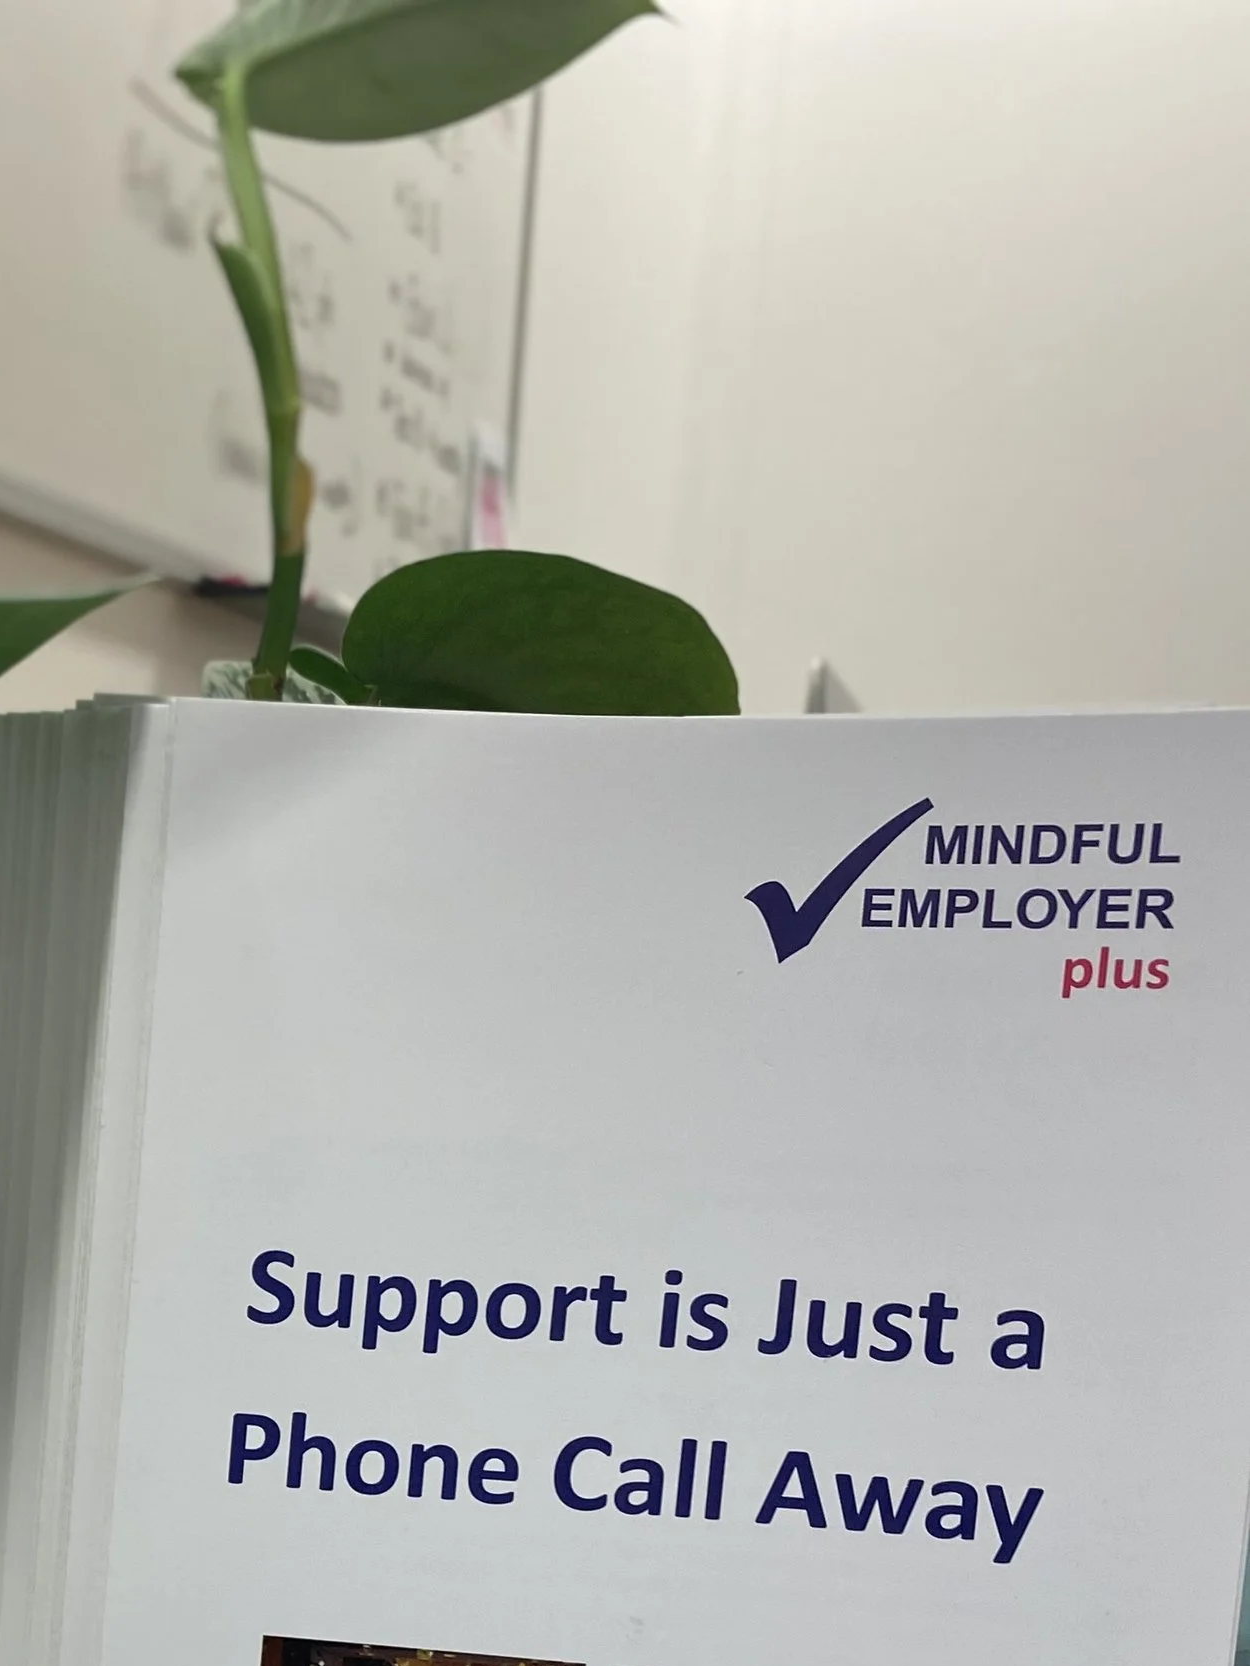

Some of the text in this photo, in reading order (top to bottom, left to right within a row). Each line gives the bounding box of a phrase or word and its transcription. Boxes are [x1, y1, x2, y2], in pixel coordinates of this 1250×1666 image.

[924, 823, 1181, 865] MINDFUL
[861, 889, 1174, 929] EMPLOYER
[1061, 946, 1170, 998] plus
[246, 1249, 1046, 1370] Support is Just a
[227, 1412, 1045, 1564] Phone Call Away
